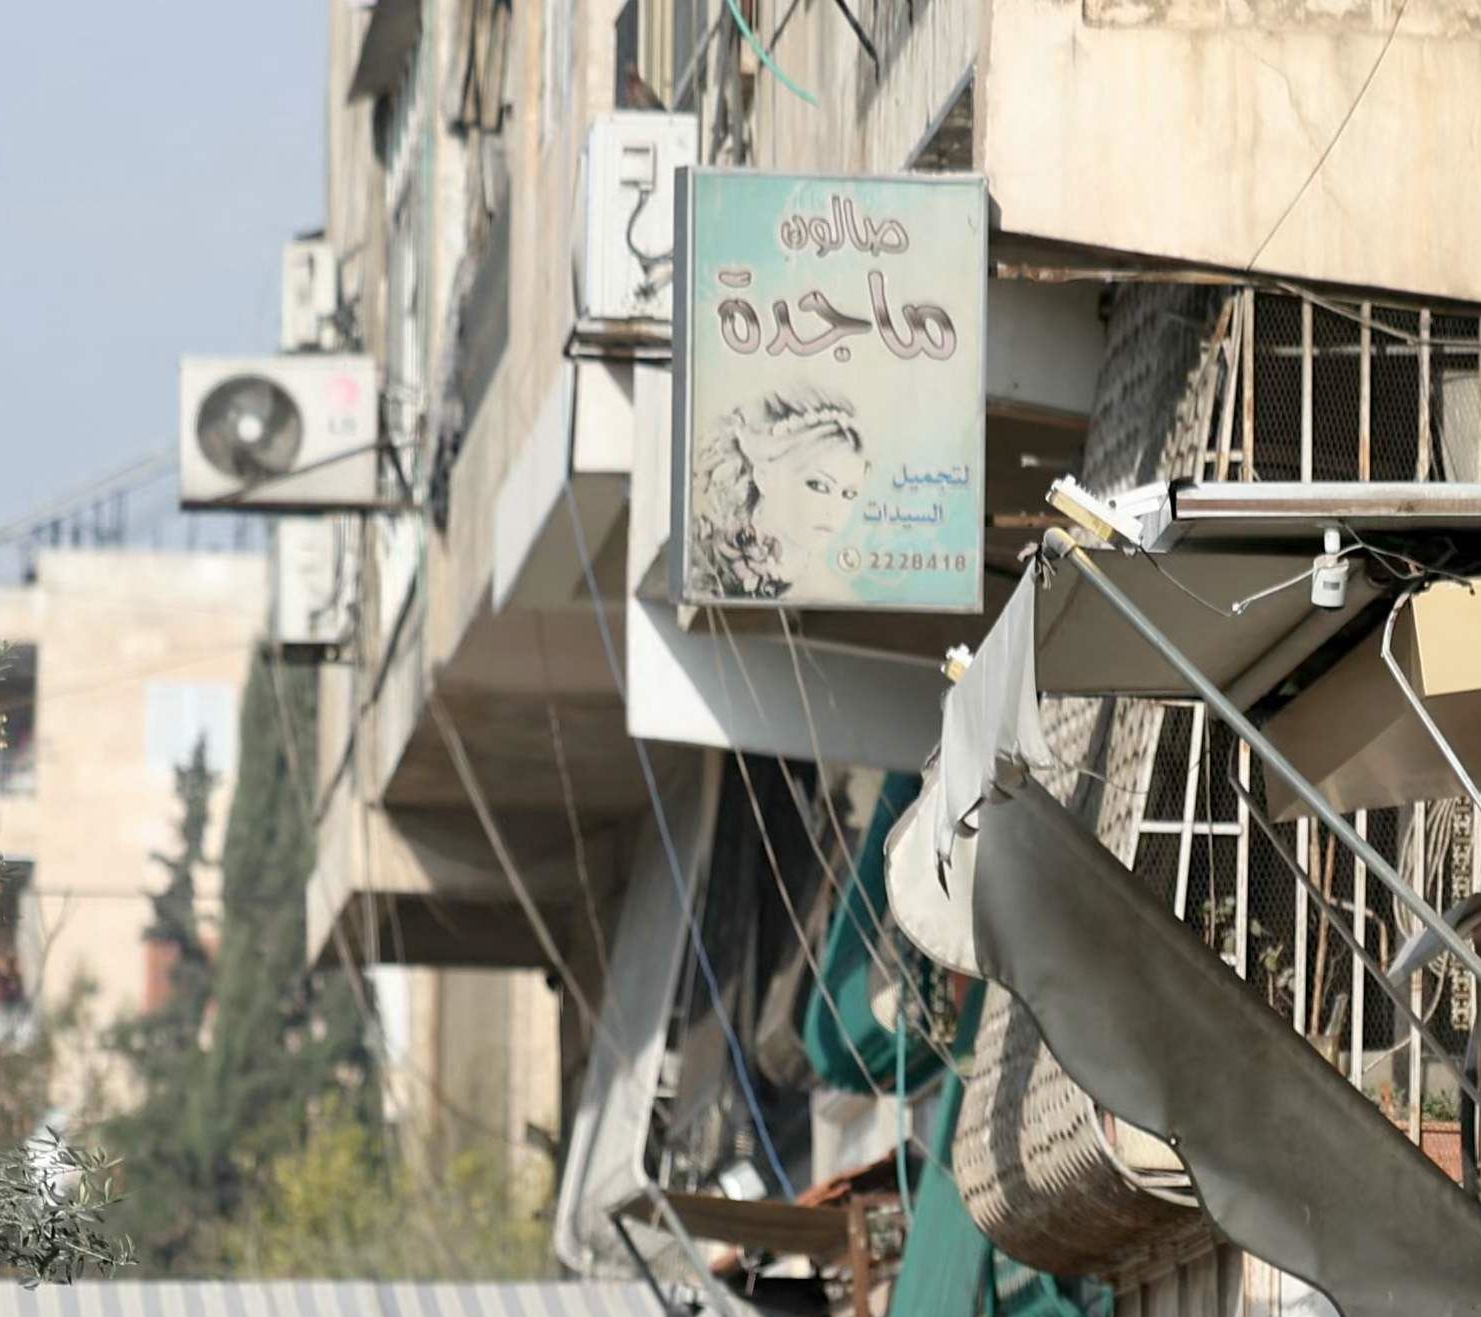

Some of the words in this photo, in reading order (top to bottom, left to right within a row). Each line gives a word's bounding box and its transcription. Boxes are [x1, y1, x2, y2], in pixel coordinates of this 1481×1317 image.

[781, 193, 909, 257] صالون
[717, 269, 957, 363] ماجدة
[892, 463, 970, 493] لتجميل
[863, 502, 944, 529] السيدات
[869, 551, 967, 572] 2228418
